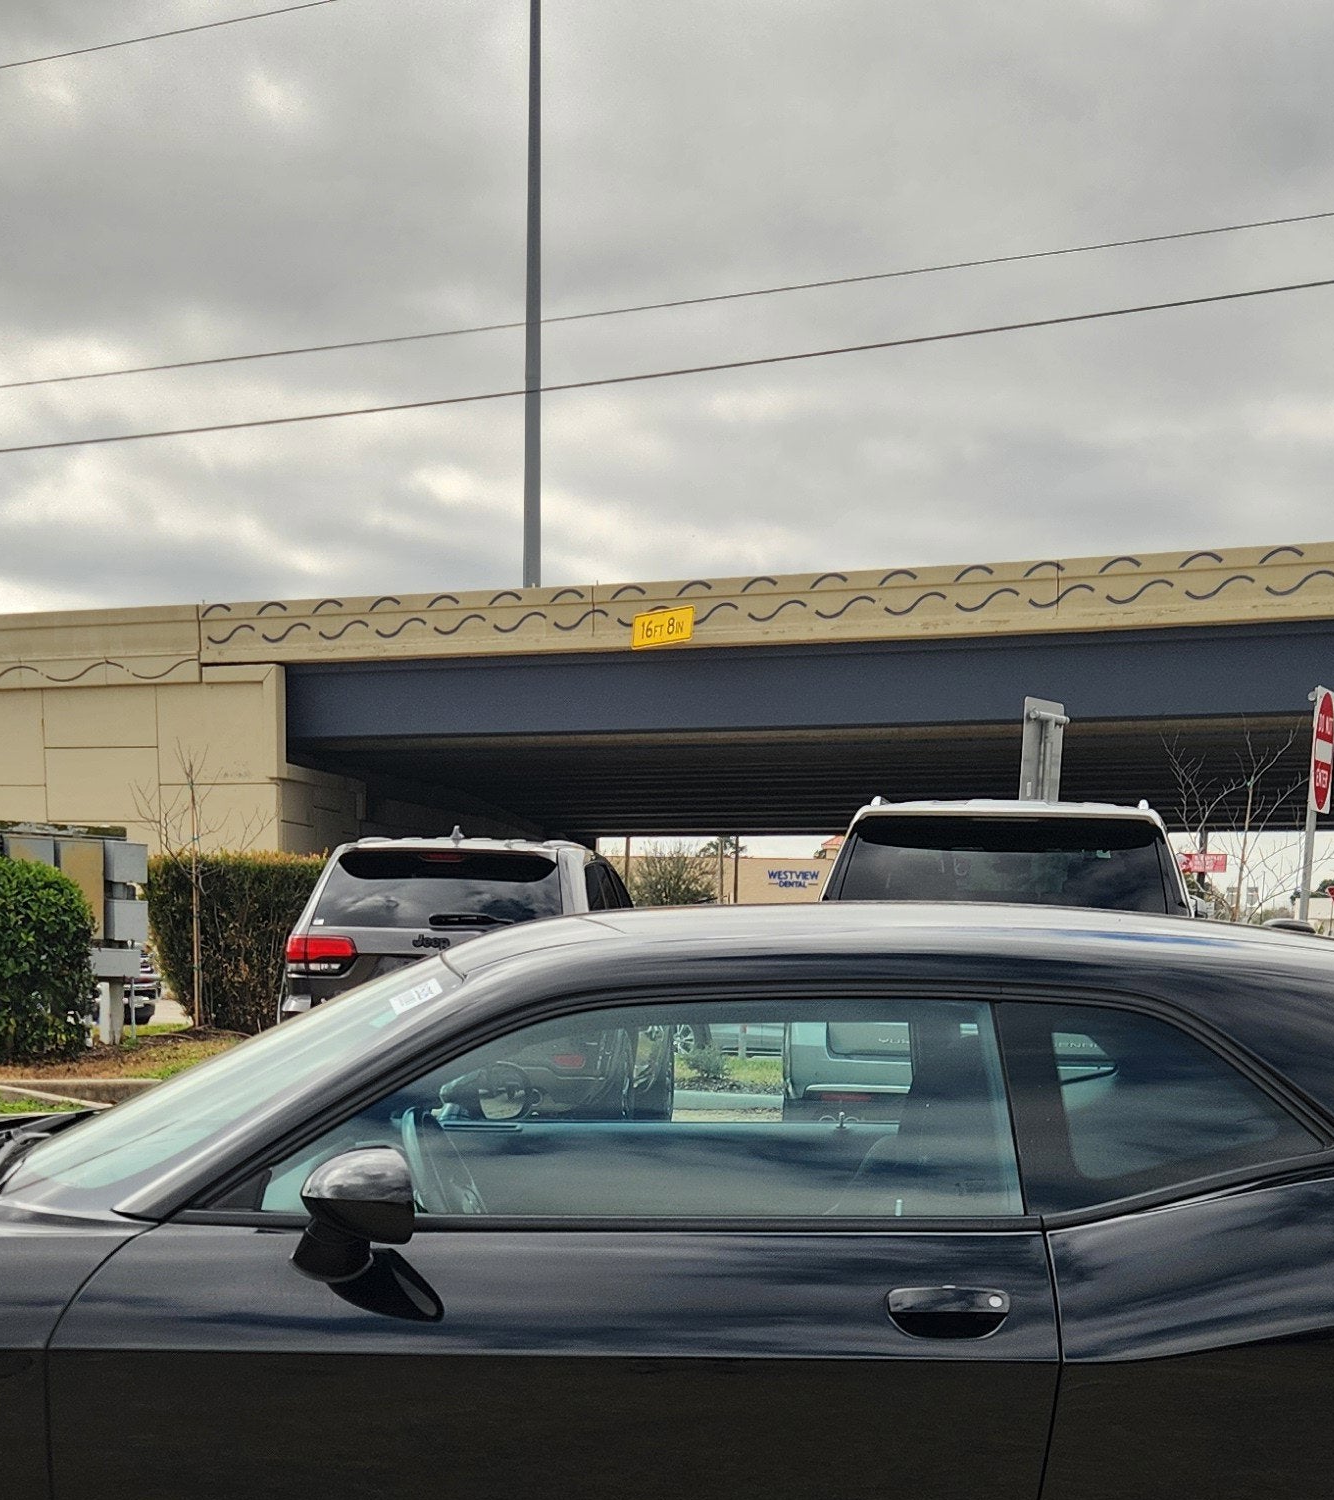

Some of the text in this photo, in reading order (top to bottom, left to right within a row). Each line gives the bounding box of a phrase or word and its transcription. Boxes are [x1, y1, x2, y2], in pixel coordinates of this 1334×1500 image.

[767, 869, 820, 880] WESTVIEW
[778, 880, 807, 889] DENTAL
[412, 933, 451, 951] Jeep
